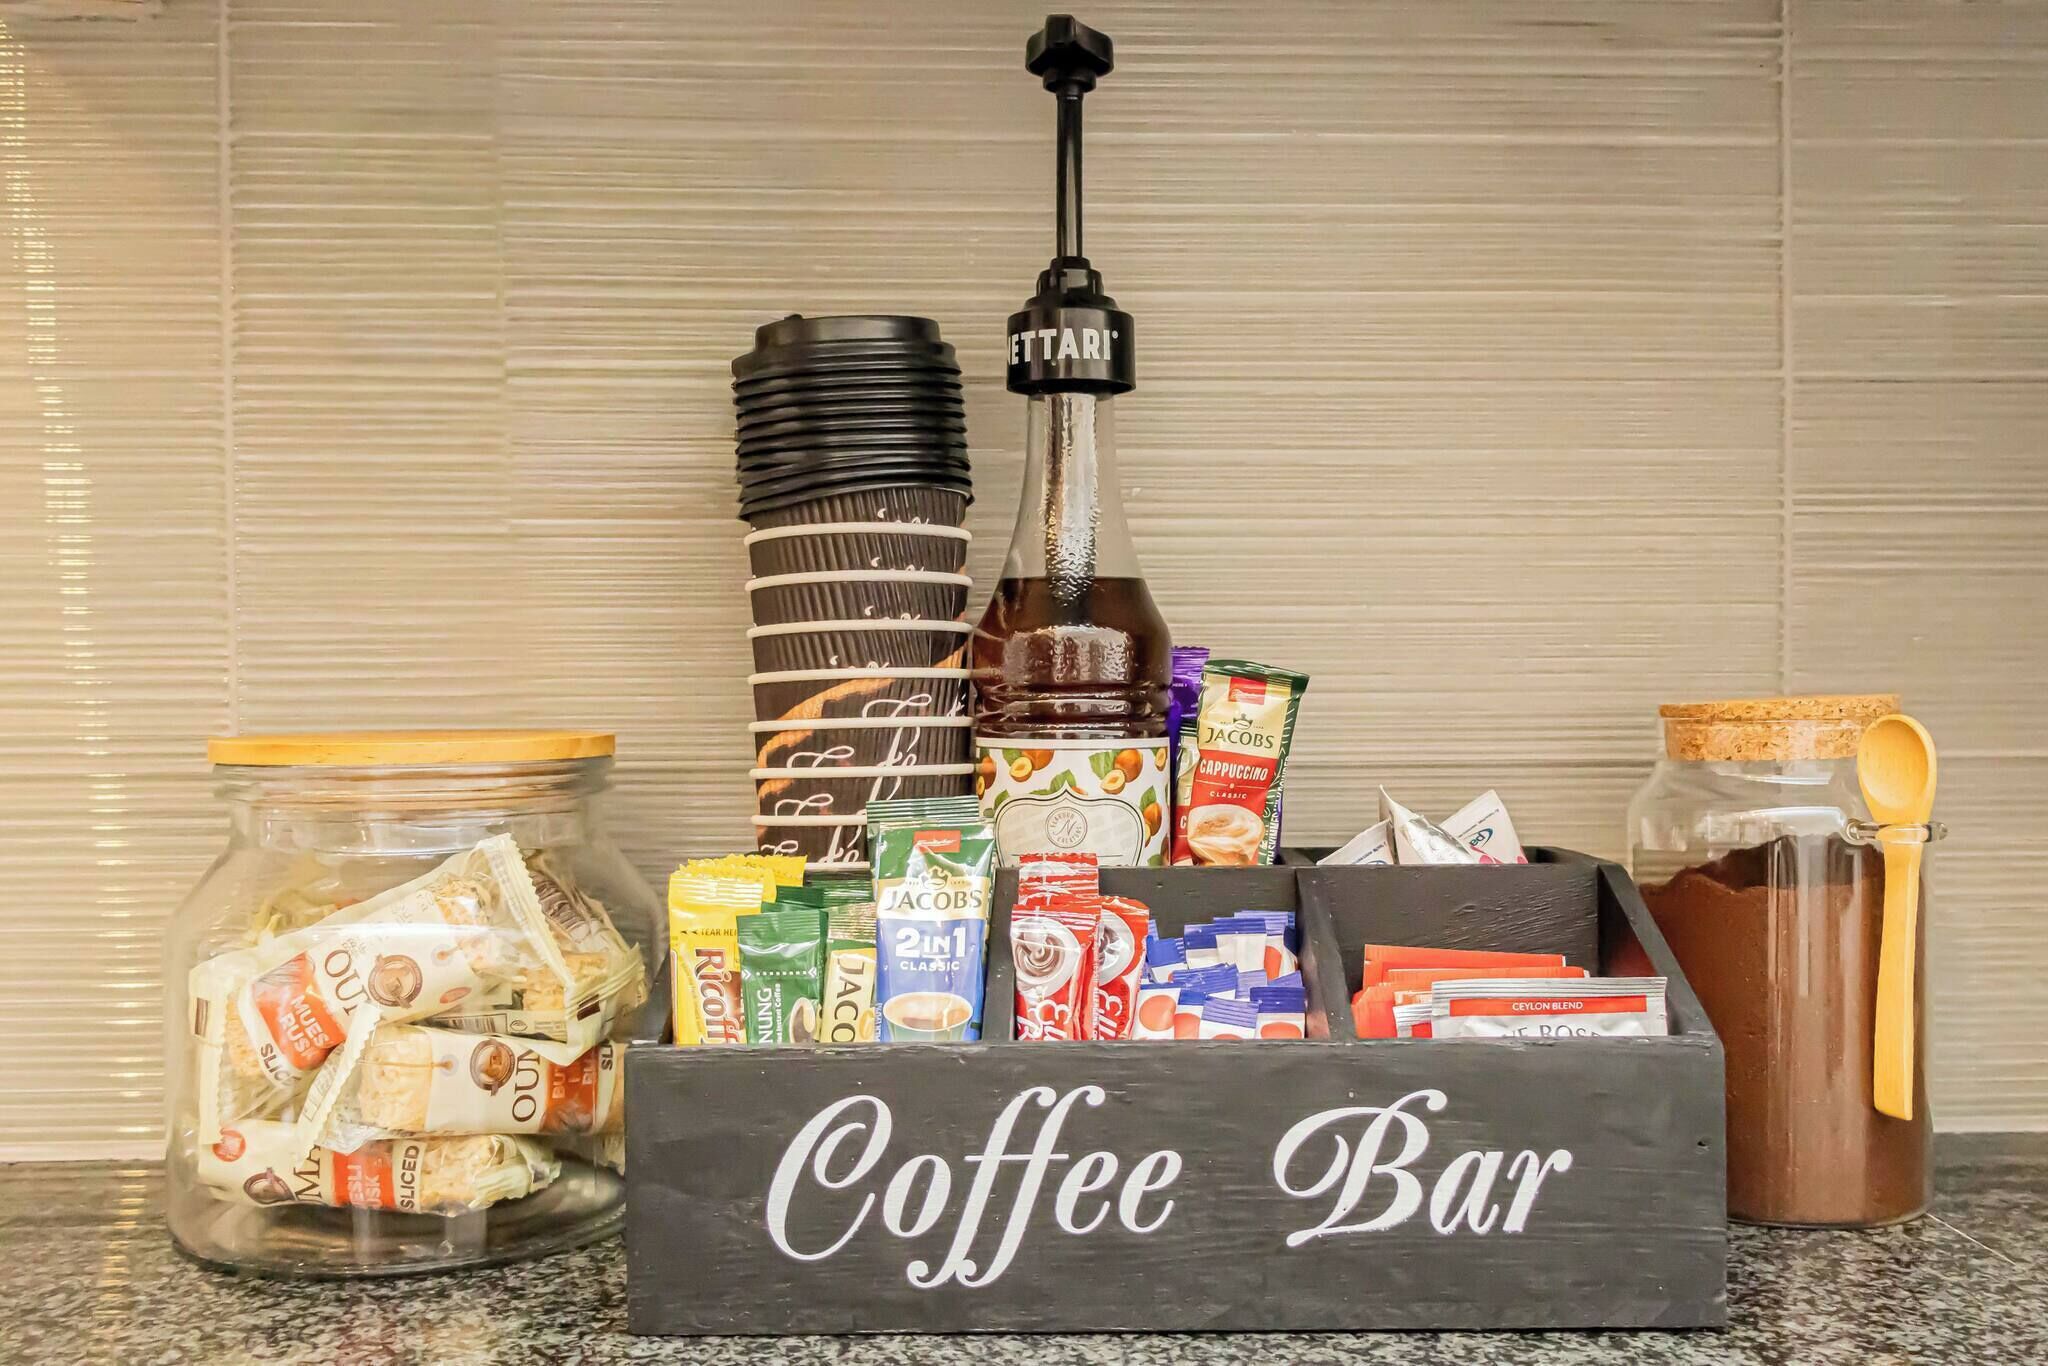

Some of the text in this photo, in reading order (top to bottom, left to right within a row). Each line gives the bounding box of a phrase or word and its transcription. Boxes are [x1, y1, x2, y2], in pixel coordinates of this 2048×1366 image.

[1008, 327, 1111, 366] ETTARI
[1205, 727, 1275, 750] JACOBS
[1200, 758, 1269, 781] CAPPUCCINO
[1209, 790, 1248, 800] CLASSIC
[884, 889, 983, 911] JACOBS
[899, 960, 961, 972] CLASSIC
[695, 948, 741, 1044] Ricoff
[1511, 1001, 1584, 1012] CEYLON BLEND
[290, 994, 330, 1049] MUES
[400, 1144, 420, 1210] SLICED
[766, 1085, 1574, 1289] Coffee Bar
